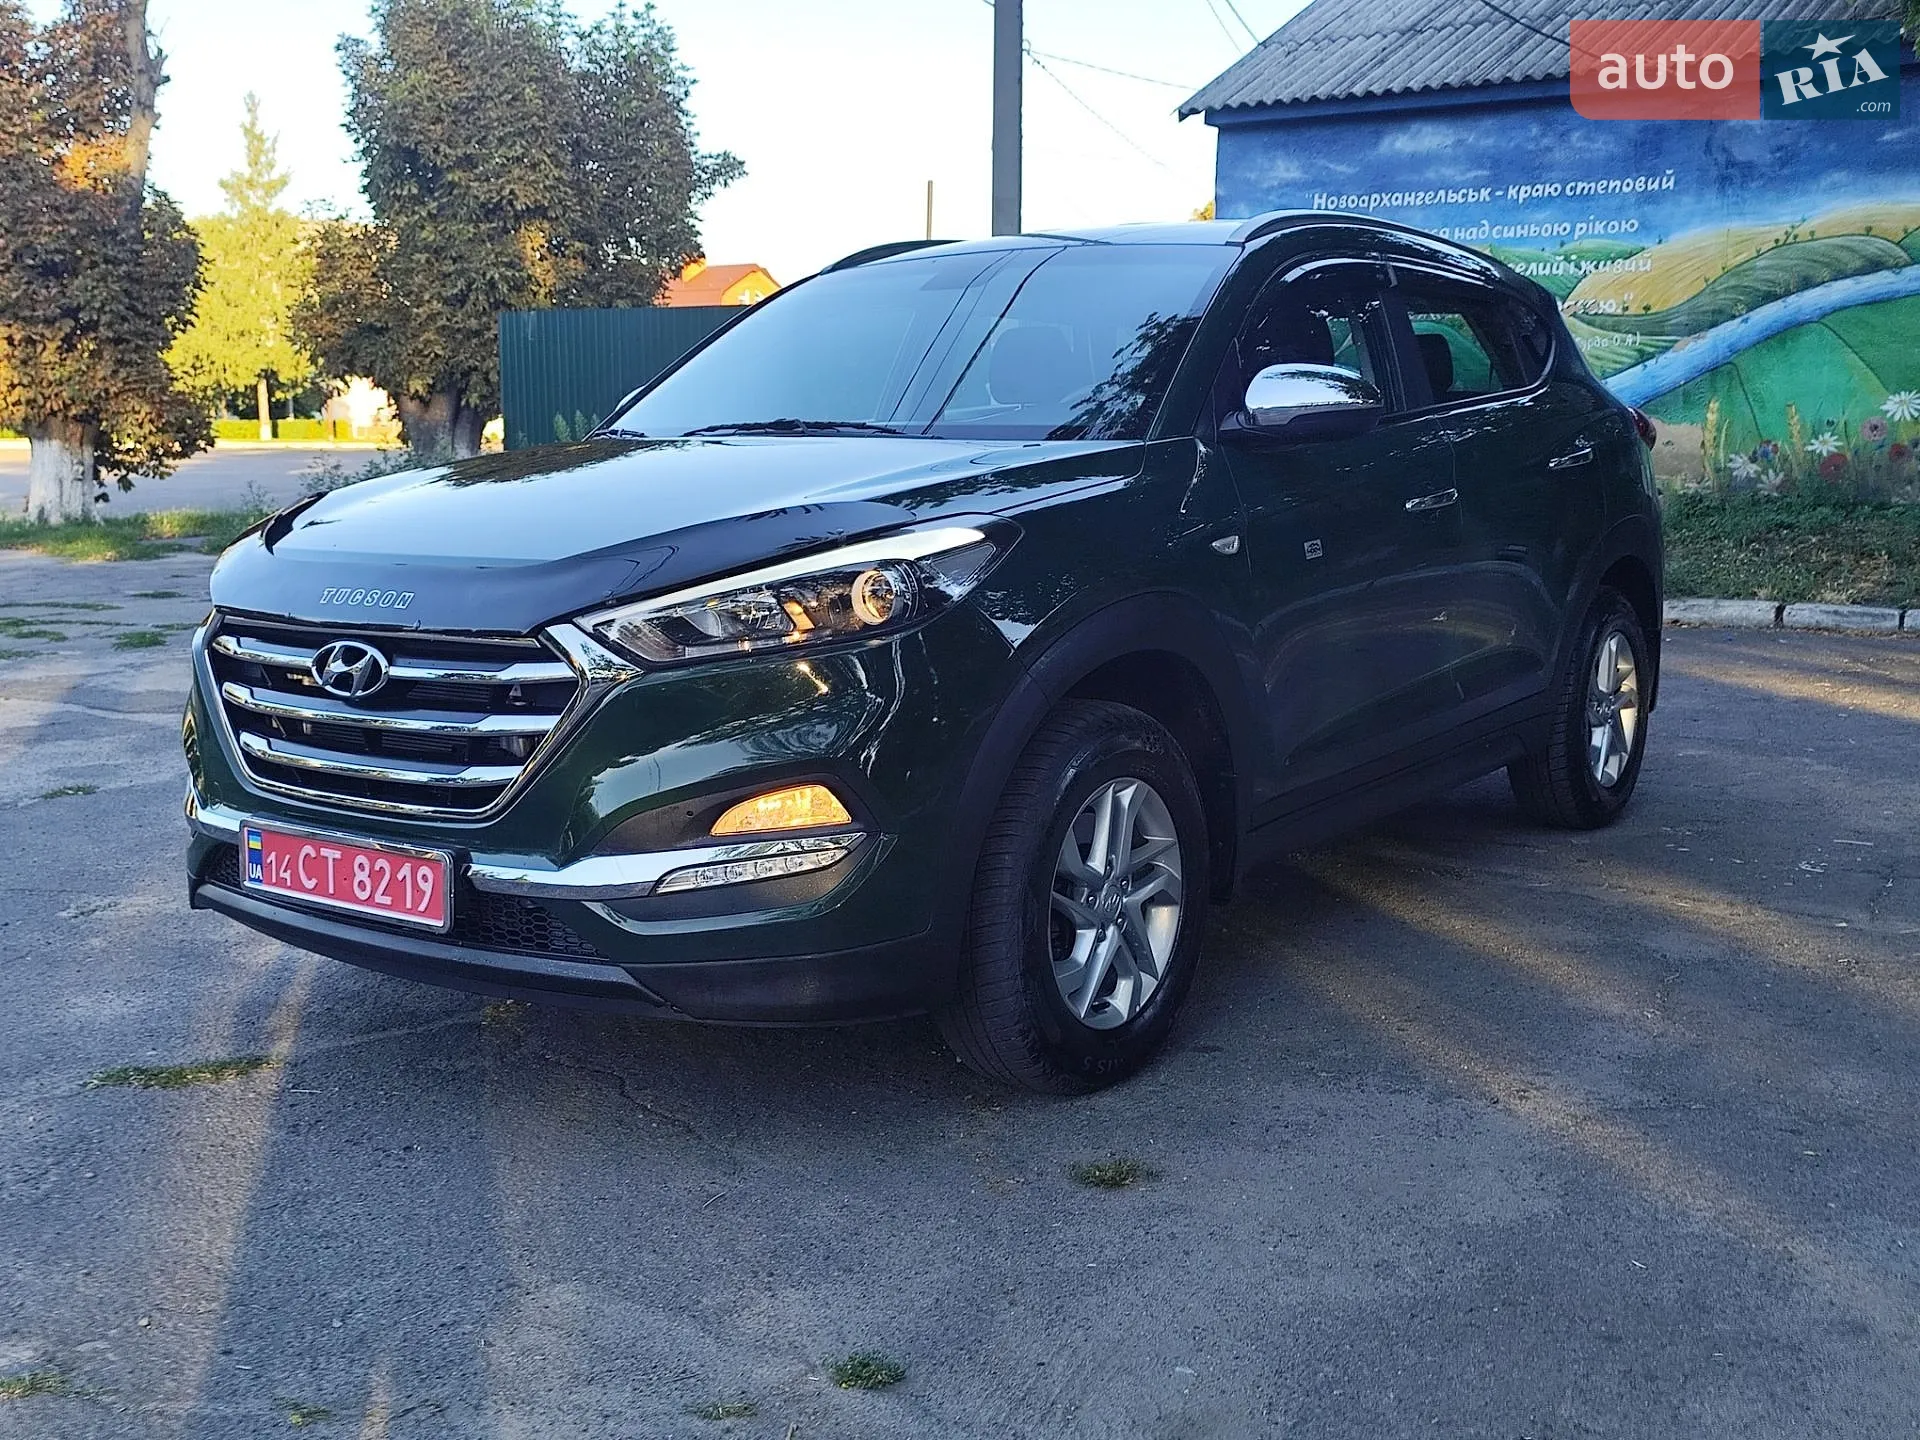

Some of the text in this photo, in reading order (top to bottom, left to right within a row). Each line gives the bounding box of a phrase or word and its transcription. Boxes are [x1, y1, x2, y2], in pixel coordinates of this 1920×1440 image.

[1507, 182, 1562, 204] краю
[1565, 169, 1676, 196] степовий
[1453, 219, 1490, 241] над
[1491, 222, 1571, 239] синьою
[1573, 215, 1639, 241] рікою
[1579, 252, 1652, 276] живий
[319, 587, 415, 609] TUCSON
[248, 862, 263, 880] UA
[352, 854, 435, 913] 8219
